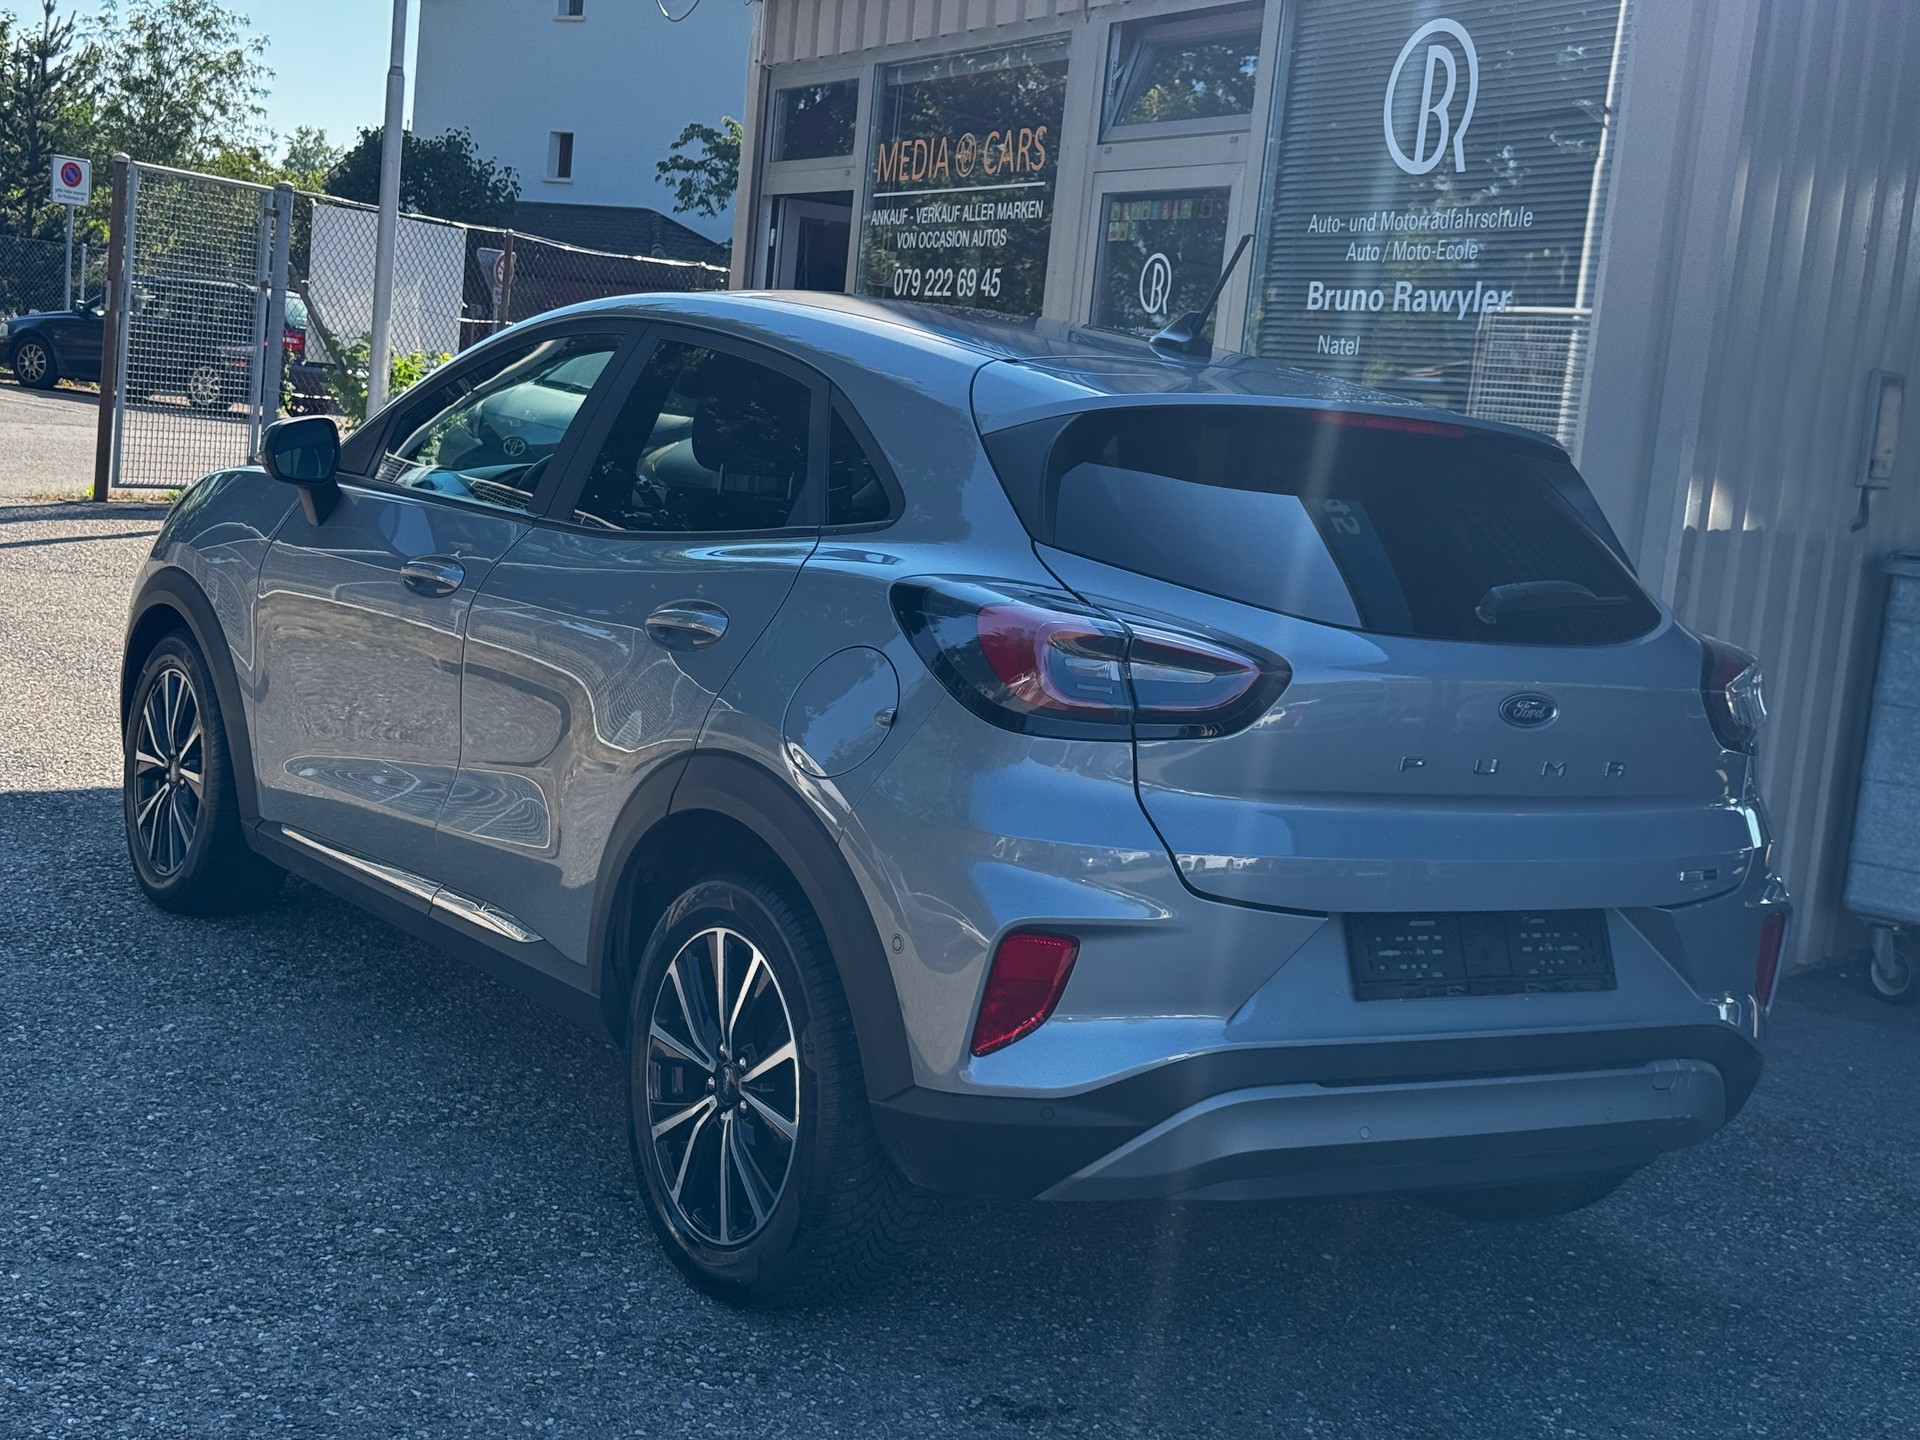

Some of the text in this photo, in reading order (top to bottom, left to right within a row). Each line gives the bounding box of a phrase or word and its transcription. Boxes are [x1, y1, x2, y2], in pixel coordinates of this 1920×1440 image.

[877, 136, 949, 183] MEDIA
[983, 125, 1047, 175] CARS
[870, 208, 908, 226] ANKAUF
[916, 205, 961, 224] VERKAUF
[962, 203, 994, 221] ALLER
[997, 200, 1044, 220] MARKEN
[1308, 206, 1533, 233] Auto- und Motorradfahrschule
[897, 228, 1007, 249] VON OCCASION AUTOS
[1345, 242, 1380, 261] Auto
[1392, 239, 1478, 260] Moto-Ecole
[893, 268, 1001, 297] 079 222 69 45
[1306, 281, 1513, 320] Bruno Rawyler
[1317, 335, 1360, 355] Natel
[1399, 755, 1626, 777] PUMA
